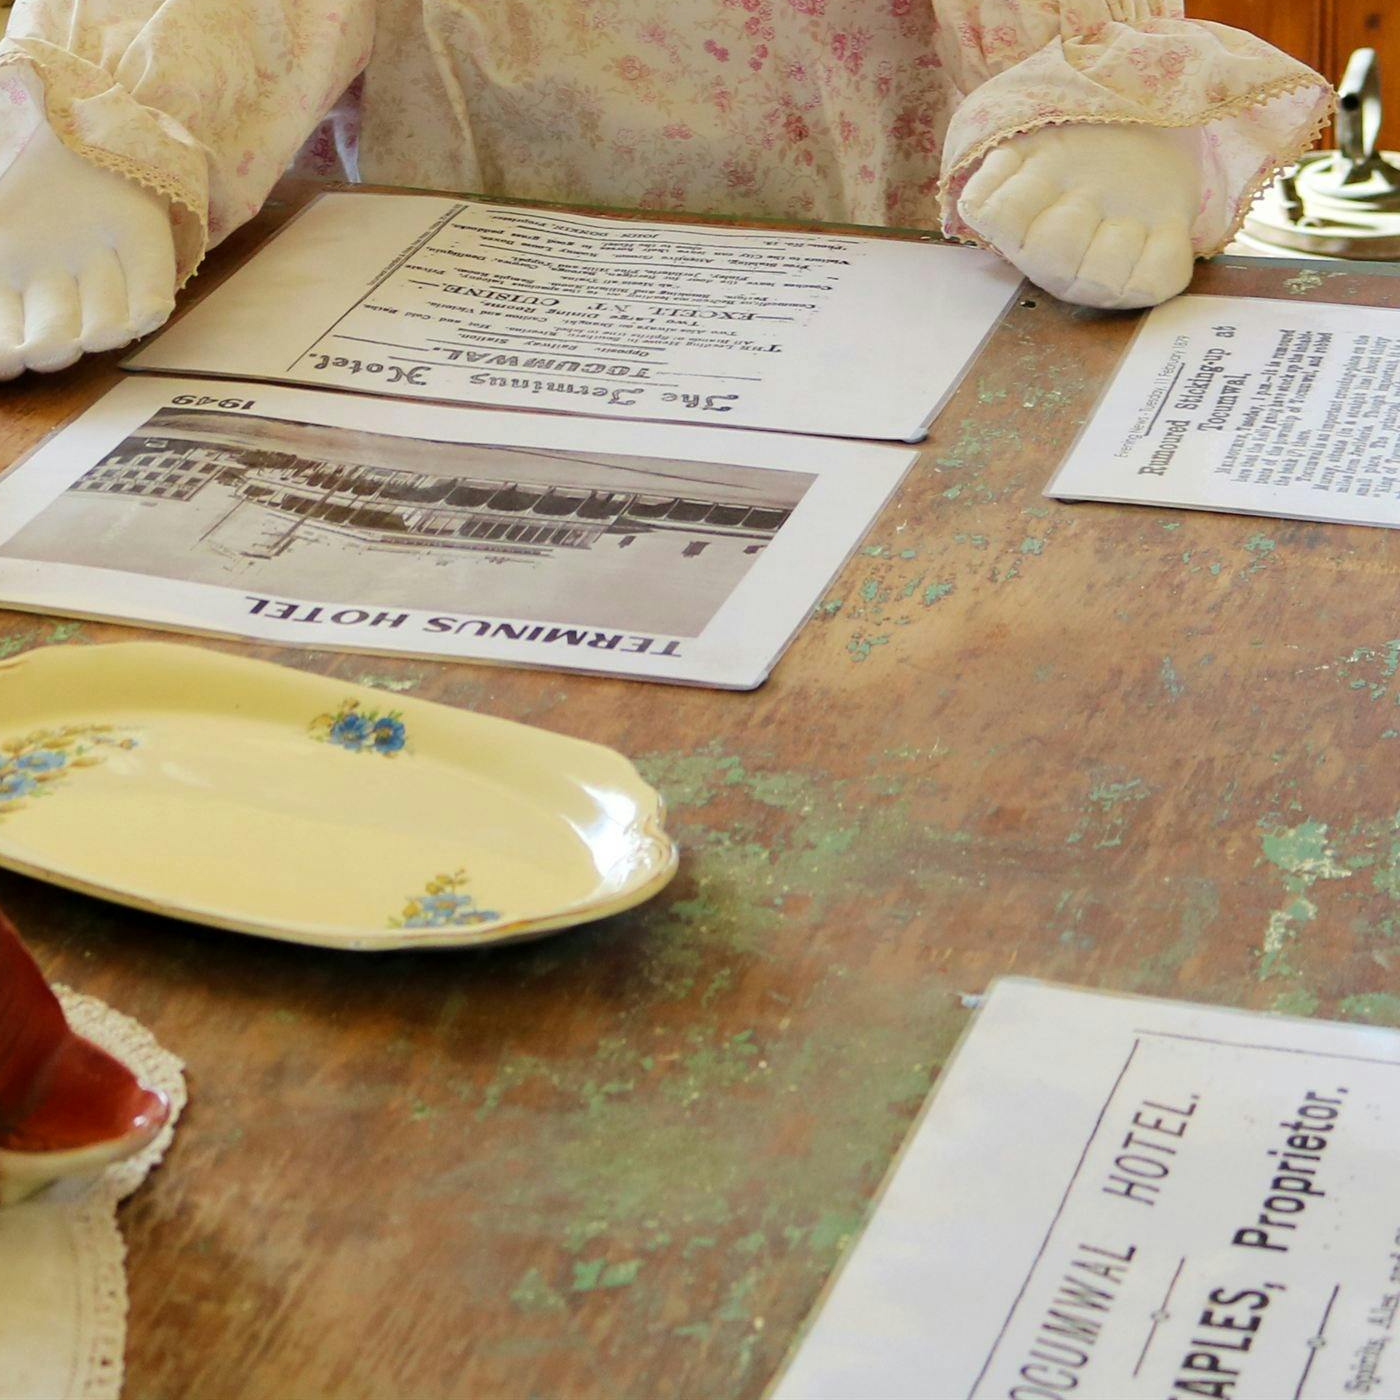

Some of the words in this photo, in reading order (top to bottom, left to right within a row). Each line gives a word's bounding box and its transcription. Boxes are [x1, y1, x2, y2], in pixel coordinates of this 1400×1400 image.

[587, 302, 758, 321] EXCELLNT
[308, 353, 432, 386] Hotel.
[432, 346, 651, 379] TOCUMWAL.
[171, 394, 256, 410] 1949
[469, 372, 645, 406] Terminus
[661, 392, 740, 412] The
[1113, 434, 1144, 458] Evening
[1157, 350, 1186, 376] February
[1137, 419, 1191, 476] Rumoured
[1174, 348, 1232, 410] Sticking-up
[1250, 424, 1276, 442] Kelly
[245, 596, 410, 628] HOTEL
[422, 617, 680, 658] TERMINUS
[1102, 1091, 1202, 1206] HOTEL.
[1167, 1283, 1287, 1400] APLES,
